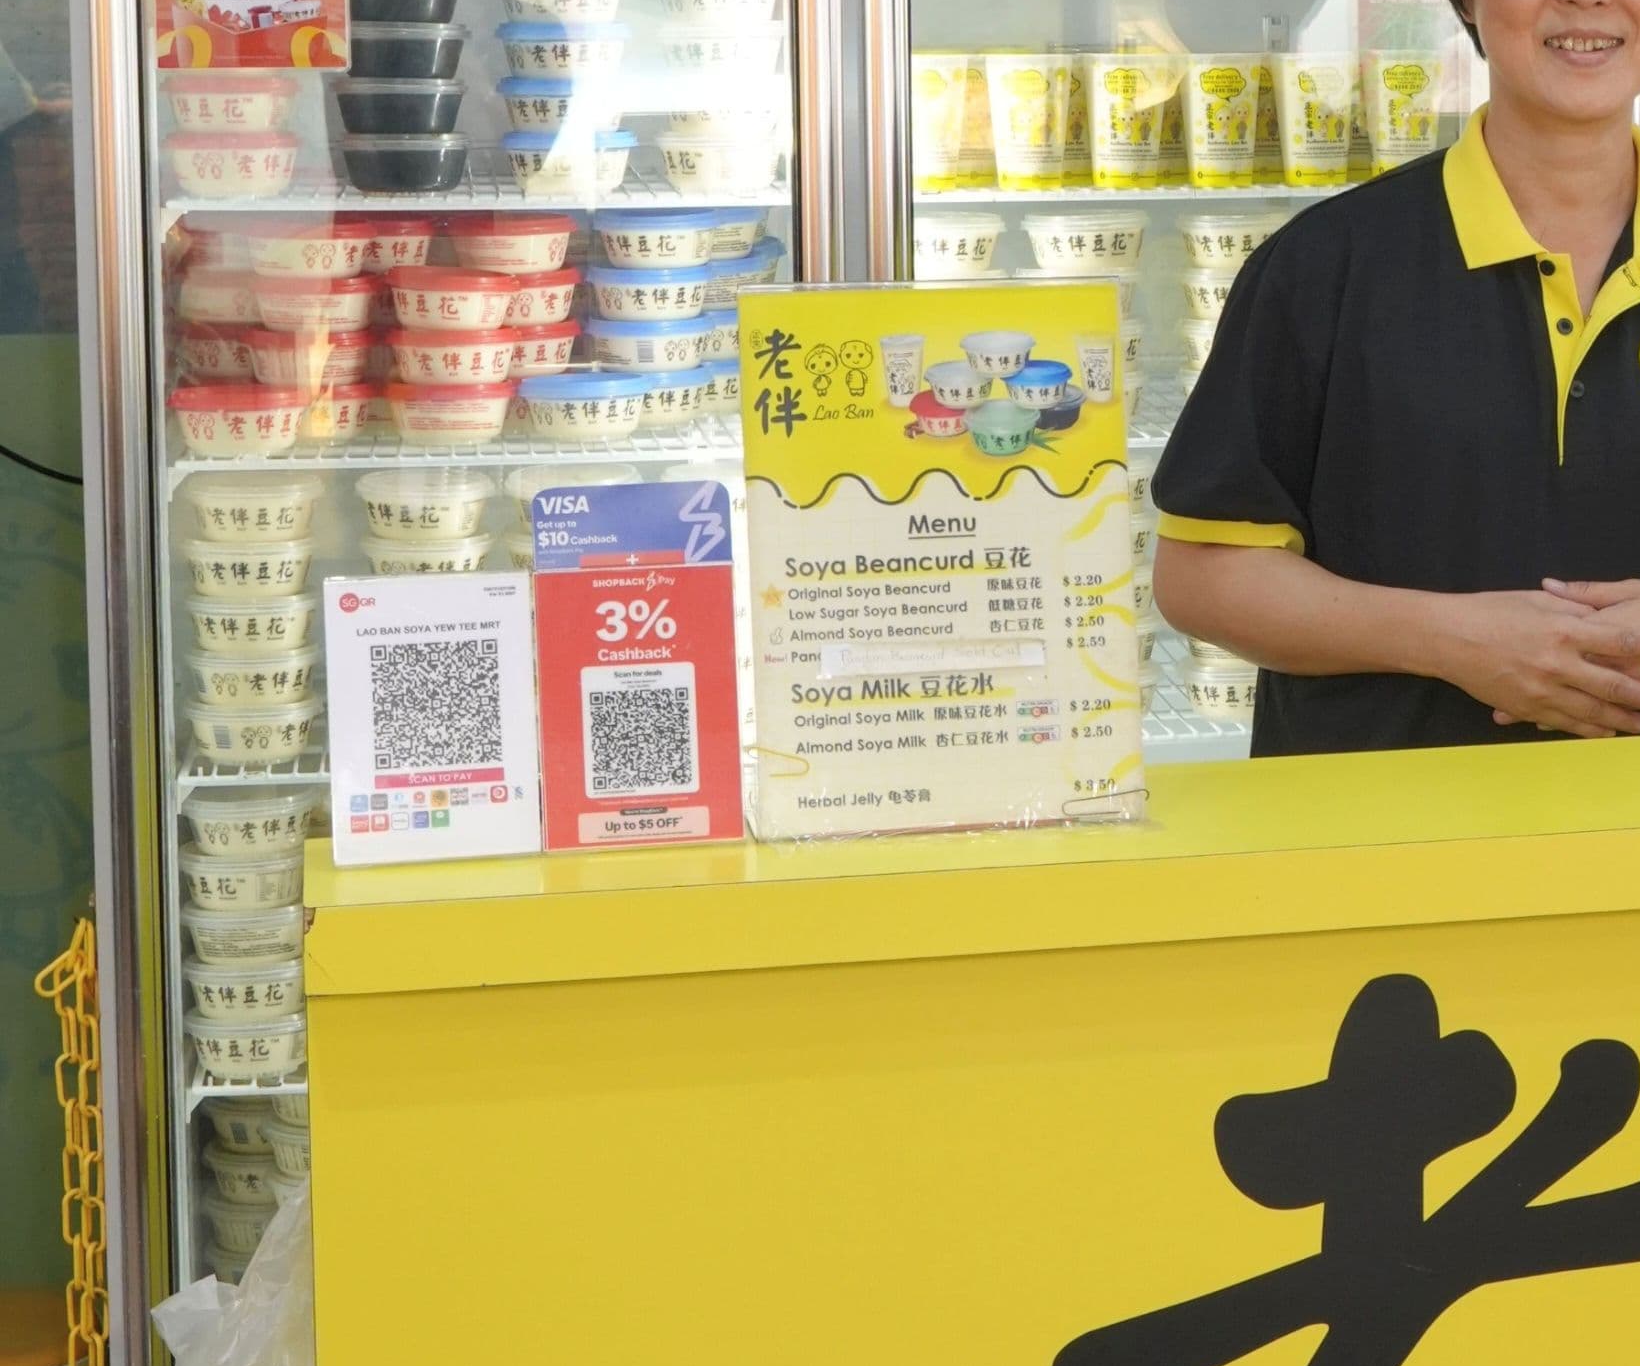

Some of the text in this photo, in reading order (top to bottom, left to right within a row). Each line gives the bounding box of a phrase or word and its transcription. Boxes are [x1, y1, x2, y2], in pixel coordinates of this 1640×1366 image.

[754, 329, 807, 438] 老伴
[813, 403, 874, 420] Lao Ban
[537, 495, 590, 515] VISA
[537, 520, 576, 530] Get up to
[908, 514, 976, 535] Menu
[538, 531, 617, 548] $10 Cashback
[785, 547, 1032, 580] Soya Beancurd 豆花
[593, 574, 675, 587] SHOPBACK Pay
[788, 587, 842, 601] Original
[847, 587, 880, 599] Soya
[885, 582, 951, 595] Beancurd
[1074, 575, 1102, 586] 2.20
[789, 608, 815, 620] Low
[820, 608, 859, 620] Sugar
[863, 606, 897, 618] Soya
[900, 600, 968, 615] Beancurd
[1076, 595, 1103, 607] 2.20
[356, 621, 501, 636] LAO BAN SOYA YEW TEE MRT
[596, 599, 677, 642] 3%
[790, 629, 845, 642] Almond
[849, 628, 882, 640] Soya
[887, 623, 953, 636] Beancurd
[791, 673, 994, 707] Soya Milk 豆花水
[794, 714, 851, 729] Original
[856, 712, 891, 726] Soya
[896, 709, 924, 722] Milk
[1082, 699, 1111, 711] 2.20
[796, 739, 853, 754] Almond
[858, 739, 893, 752] Soya
[897, 736, 927, 748] Milk
[1084, 725, 1112, 737] 2.50
[408, 772, 473, 785] SCAN TO PAY
[798, 793, 883, 808] Herbal Jelly
[605, 821, 621, 832] Up
[624, 821, 636, 830] to
[639, 819, 654, 830] $5
